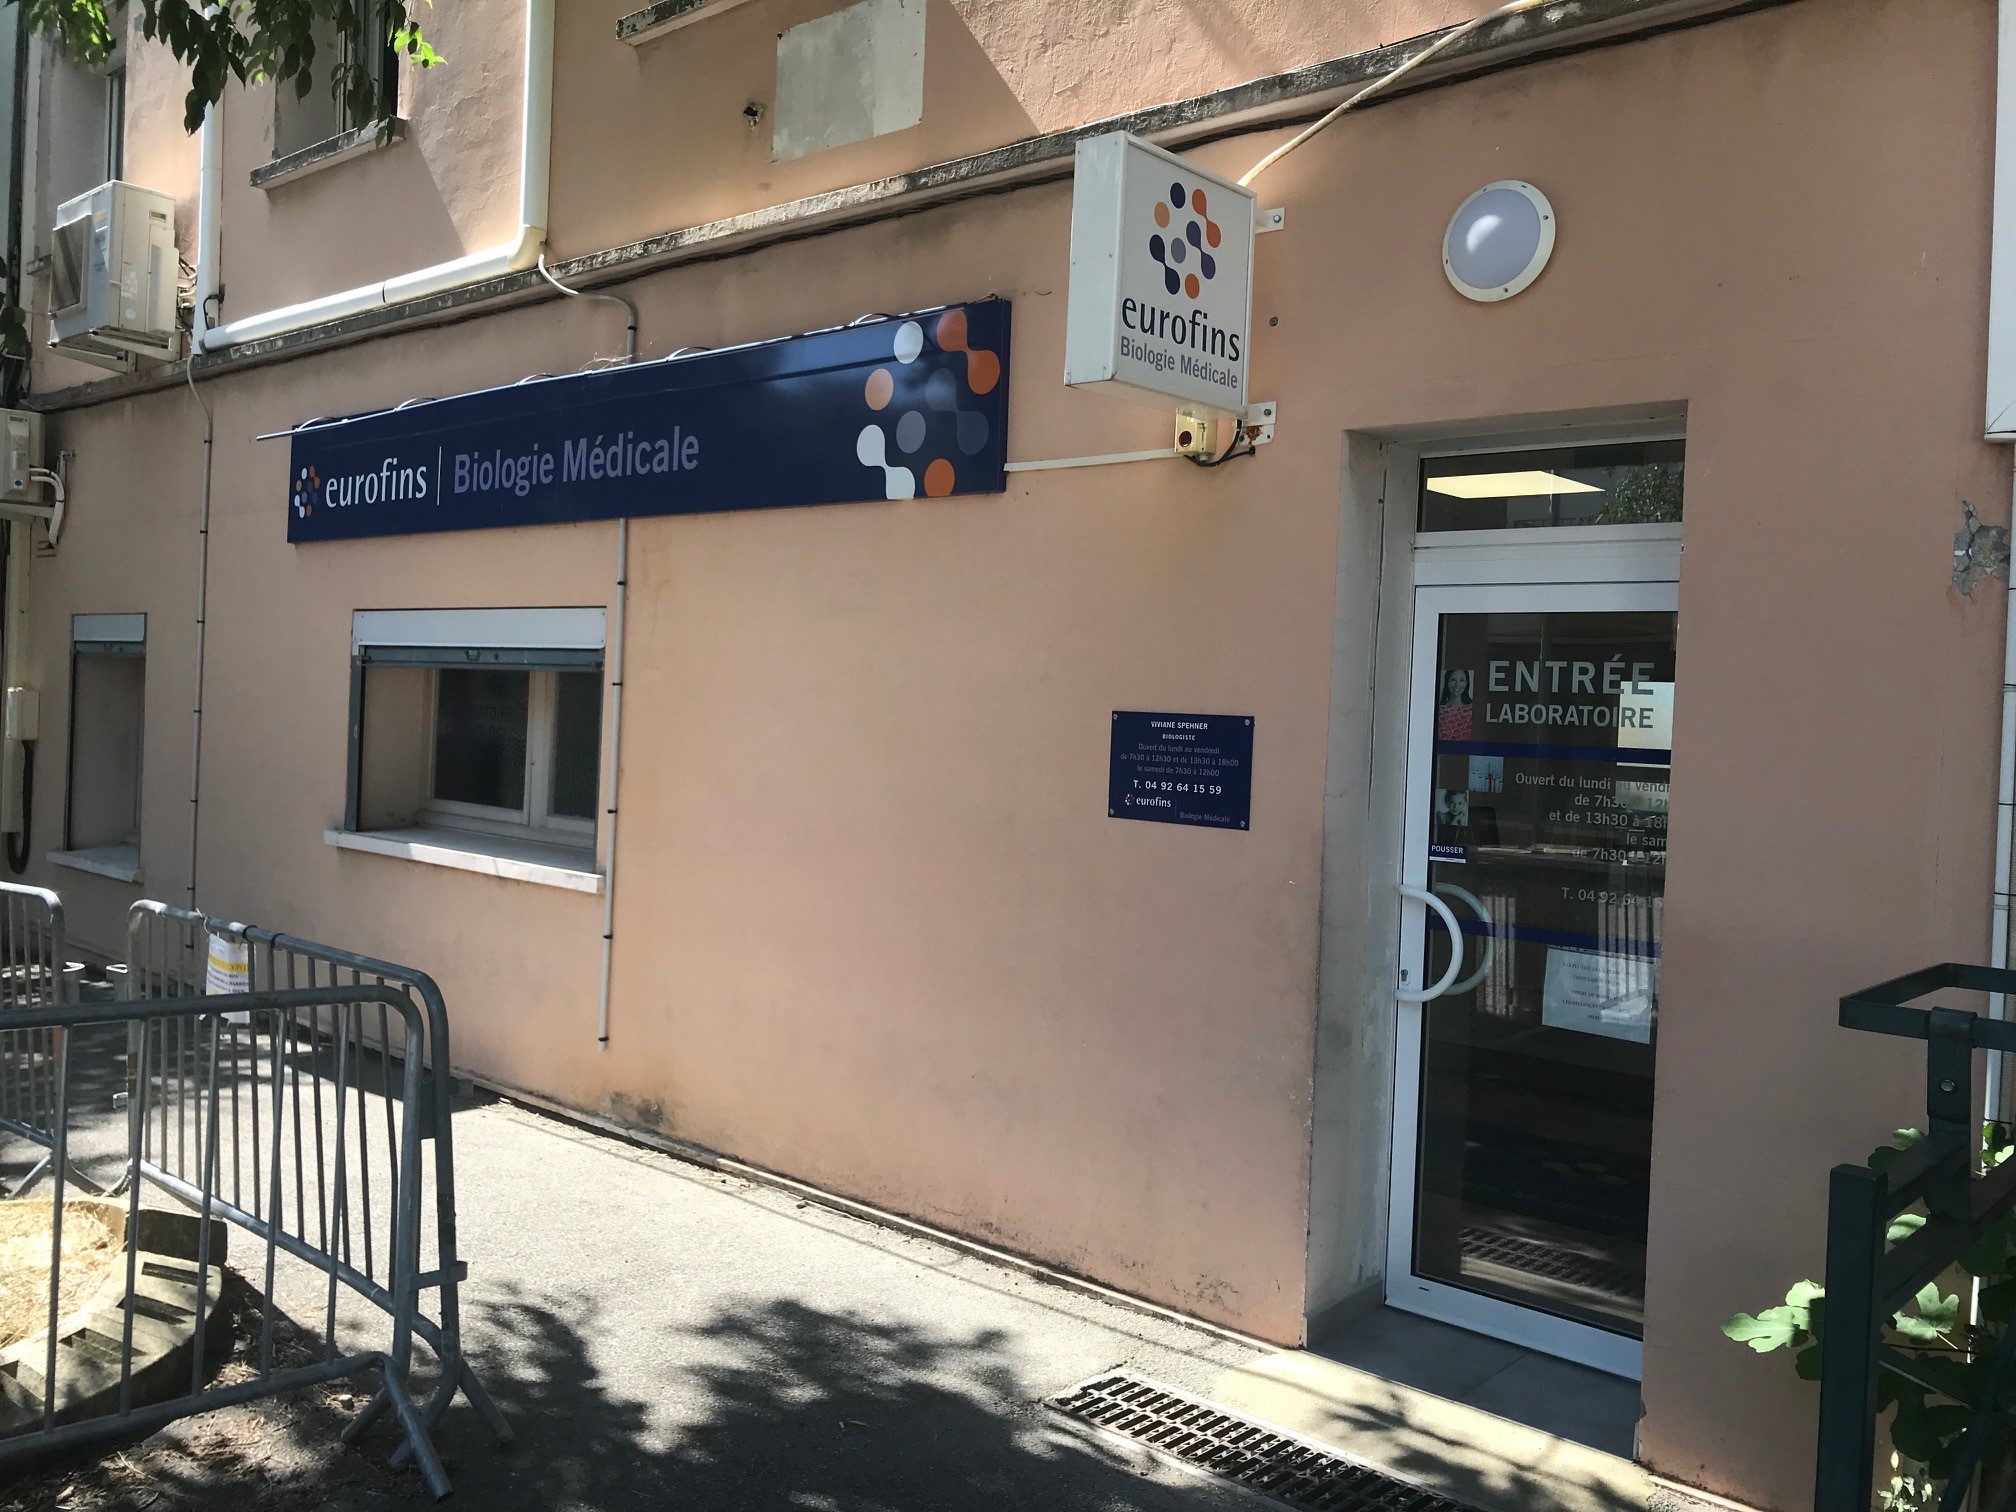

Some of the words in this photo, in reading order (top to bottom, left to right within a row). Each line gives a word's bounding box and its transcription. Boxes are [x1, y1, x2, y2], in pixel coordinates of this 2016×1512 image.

[1122, 297, 1240, 361] eurofins
[1121, 335, 1175, 371] Biologie
[1180, 354, 1238, 389] Médicale
[325, 457, 428, 508] eurofins
[453, 443, 554, 497] Biologie
[562, 425, 700, 483] Médicale
[1488, 654, 1655, 695] ENTRÉE
[1485, 703, 1654, 729] LABORATOIRE
[1178, 722, 1208, 730] SPEHNER
[1168, 744, 1183, 752] lundi
[1194, 746, 1220, 754] vendredi
[1190, 757, 1210, 765] 13h30
[1218, 758, 1239, 766] 18h00
[1144, 765, 1164, 773] samedi
[1166, 766, 1173, 774] de
[1199, 768, 1220, 776] 12h00
[1133, 780, 1141, 788] T.
[1145, 781, 1157, 789] 04
[1160, 782, 1172, 791] 92
[1176, 783, 1188, 792] 64
[1194, 784, 1205, 793] 15
[1209, 785, 1222, 795] 59
[1515, 773, 1554, 788] Ouvert
[1559, 776, 1575, 788] du
[1579, 777, 1610, 790] lundi
[1136, 796, 1171, 808] eurofins
[1575, 794, 1590, 806] de
[1594, 795, 1628, 808] 7h30
[1180, 811, 1202, 821] Biologie
[1204, 813, 1230, 822] Médicale
[1549, 810, 1561, 821] et
[1565, 811, 1580, 822] de
[1586, 812, 1628, 826] 13h30
[1632, 815, 1639, 827] à
[1626, 832, 1637, 845] le
[1431, 845, 1464, 854] POUSSER
[1572, 847, 1587, 859] de
[1592, 848, 1627, 862] 7h30
[1561, 886, 1574, 900] T.
[1578, 889, 1596, 902] 04
[1600, 891, 1617, 904] 92
[1623, 893, 1639, 906] 64
